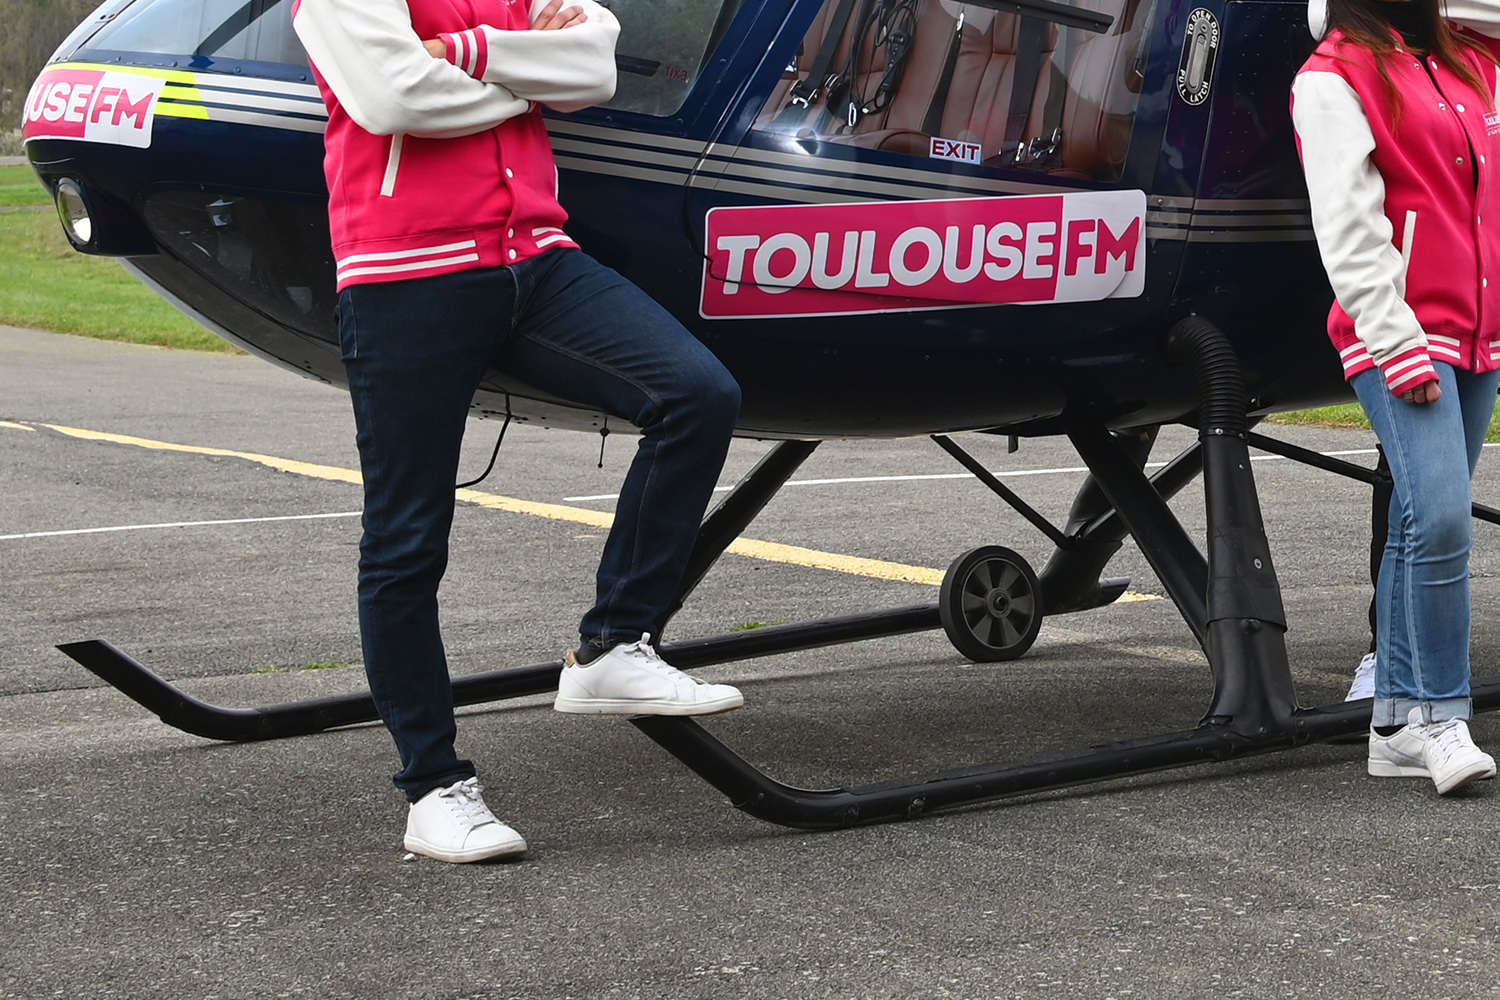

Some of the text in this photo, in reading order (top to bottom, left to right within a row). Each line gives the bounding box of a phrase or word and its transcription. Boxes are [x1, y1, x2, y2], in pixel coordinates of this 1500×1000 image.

[1187, 10, 1218, 48] TO OPEN DOOR
[1178, 69, 1209, 102] PULL LATCH
[90, 86, 154, 130] FM
[932, 139, 980, 160] EXIT
[716, 216, 1140, 294] TOULOUSE FM
